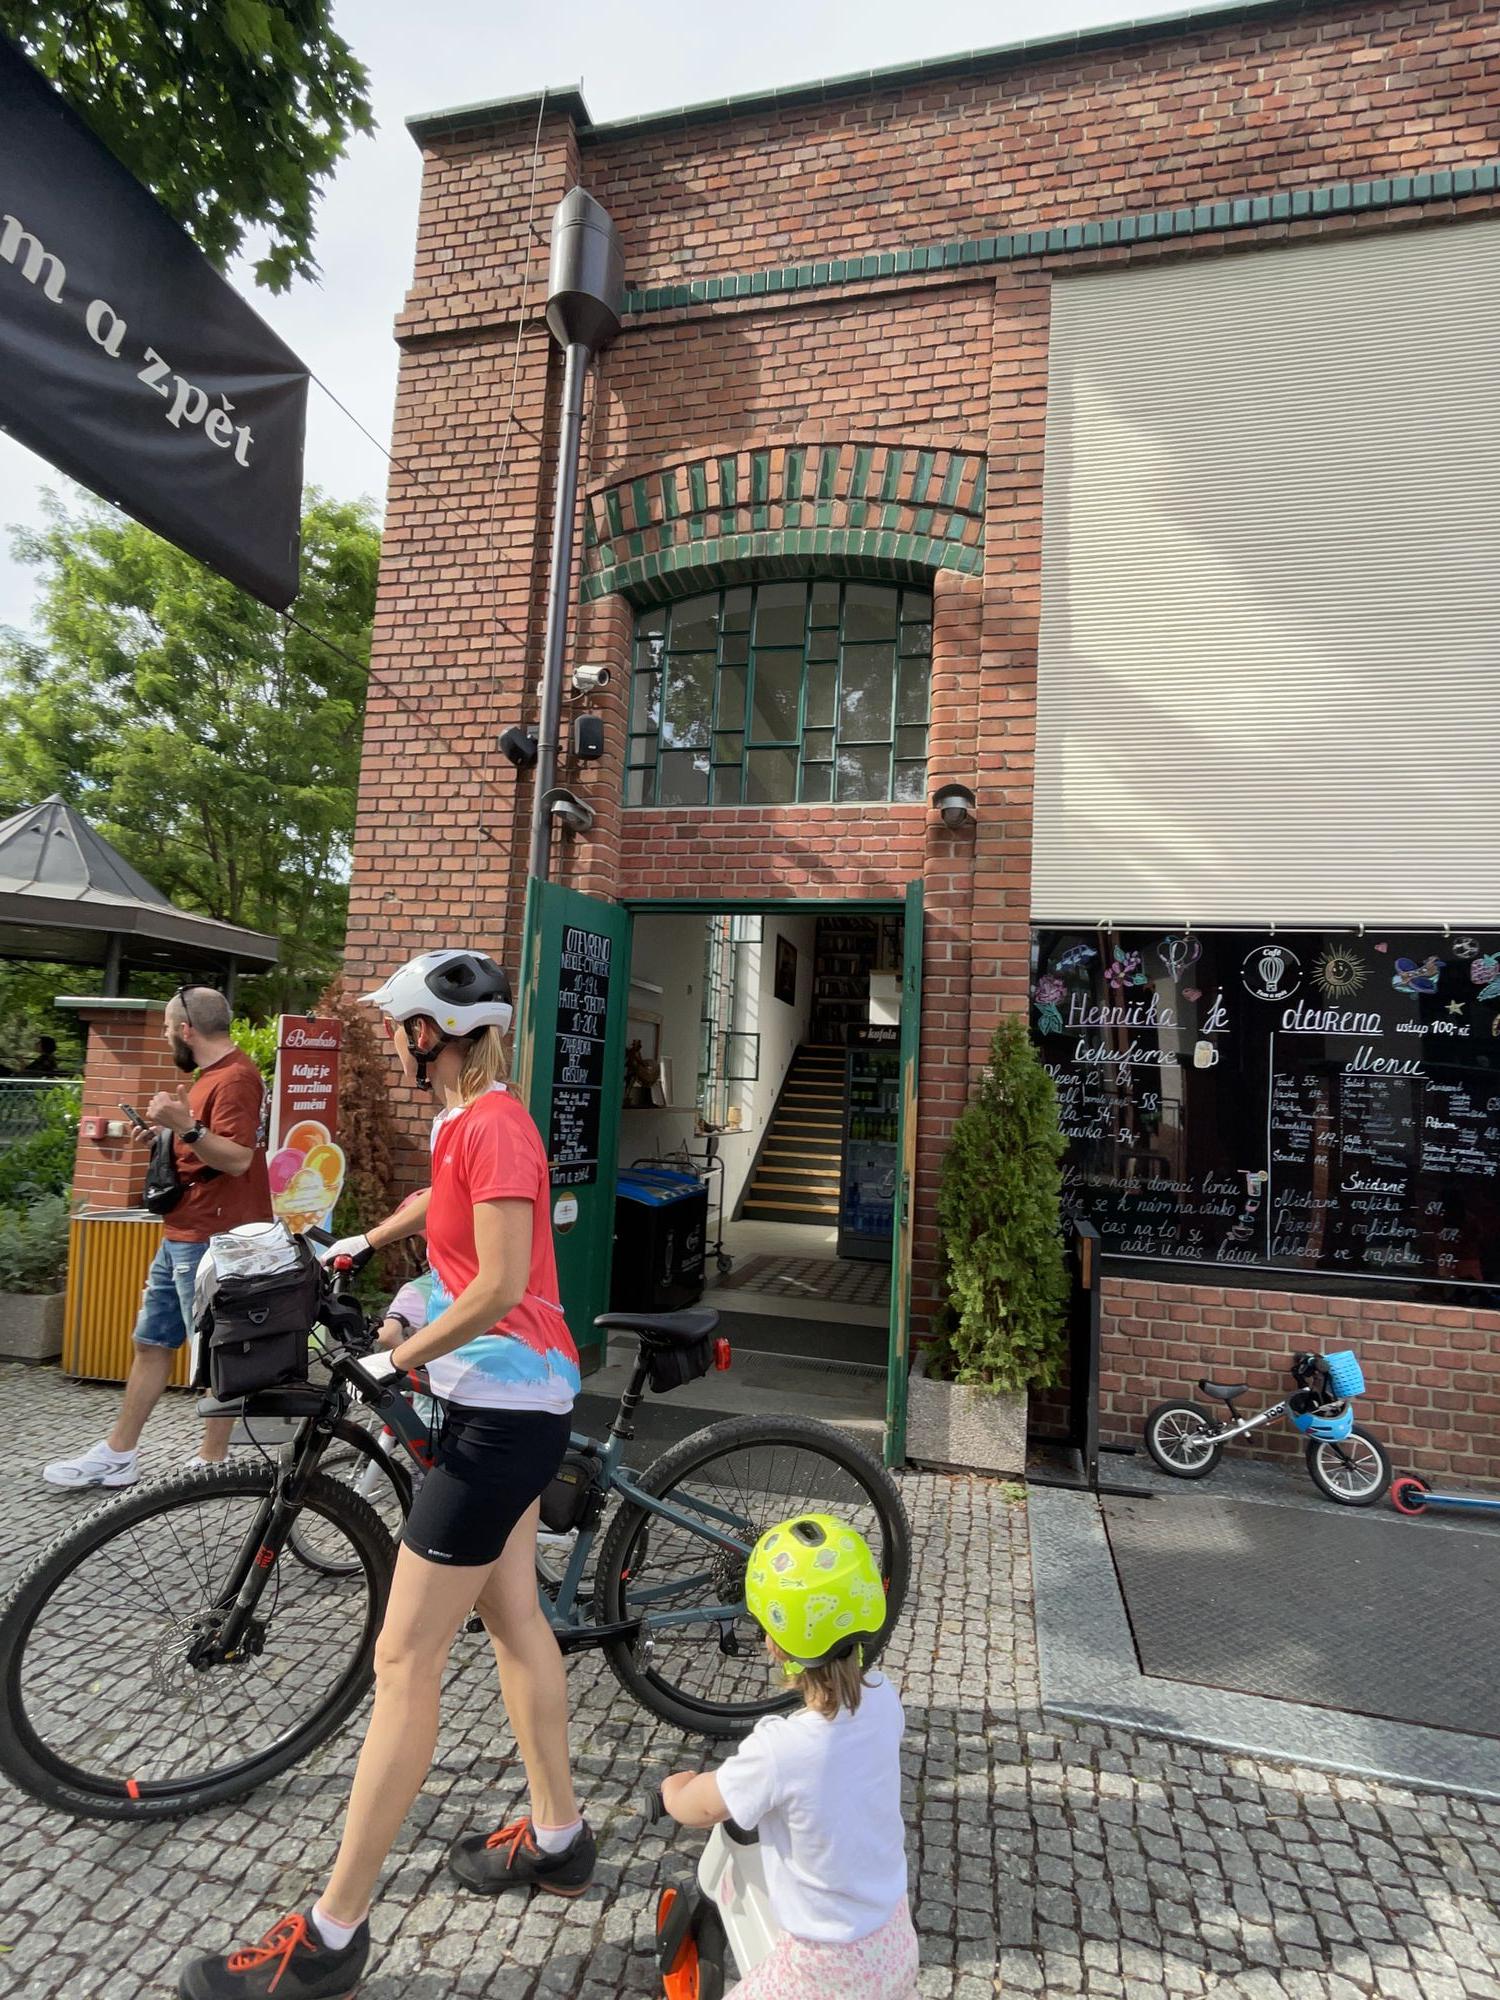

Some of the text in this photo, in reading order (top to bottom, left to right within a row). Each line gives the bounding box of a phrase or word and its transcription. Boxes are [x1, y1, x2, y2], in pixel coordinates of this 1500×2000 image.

[86, 299, 128, 358] a
[137, 346, 255, 468] zpět
[1203, 986, 1229, 1035] je
[867, 1027, 897, 1042] kofola
[1074, 1034, 1179, 1071] Čepujeme
[1345, 1045, 1426, 1076] Menu
[292, 1064, 331, 1079] Když je
[287, 1081, 333, 1094] zmrzlina
[293, 1098, 328, 1111] umění
[133, 1797, 183, 1811] TOM
